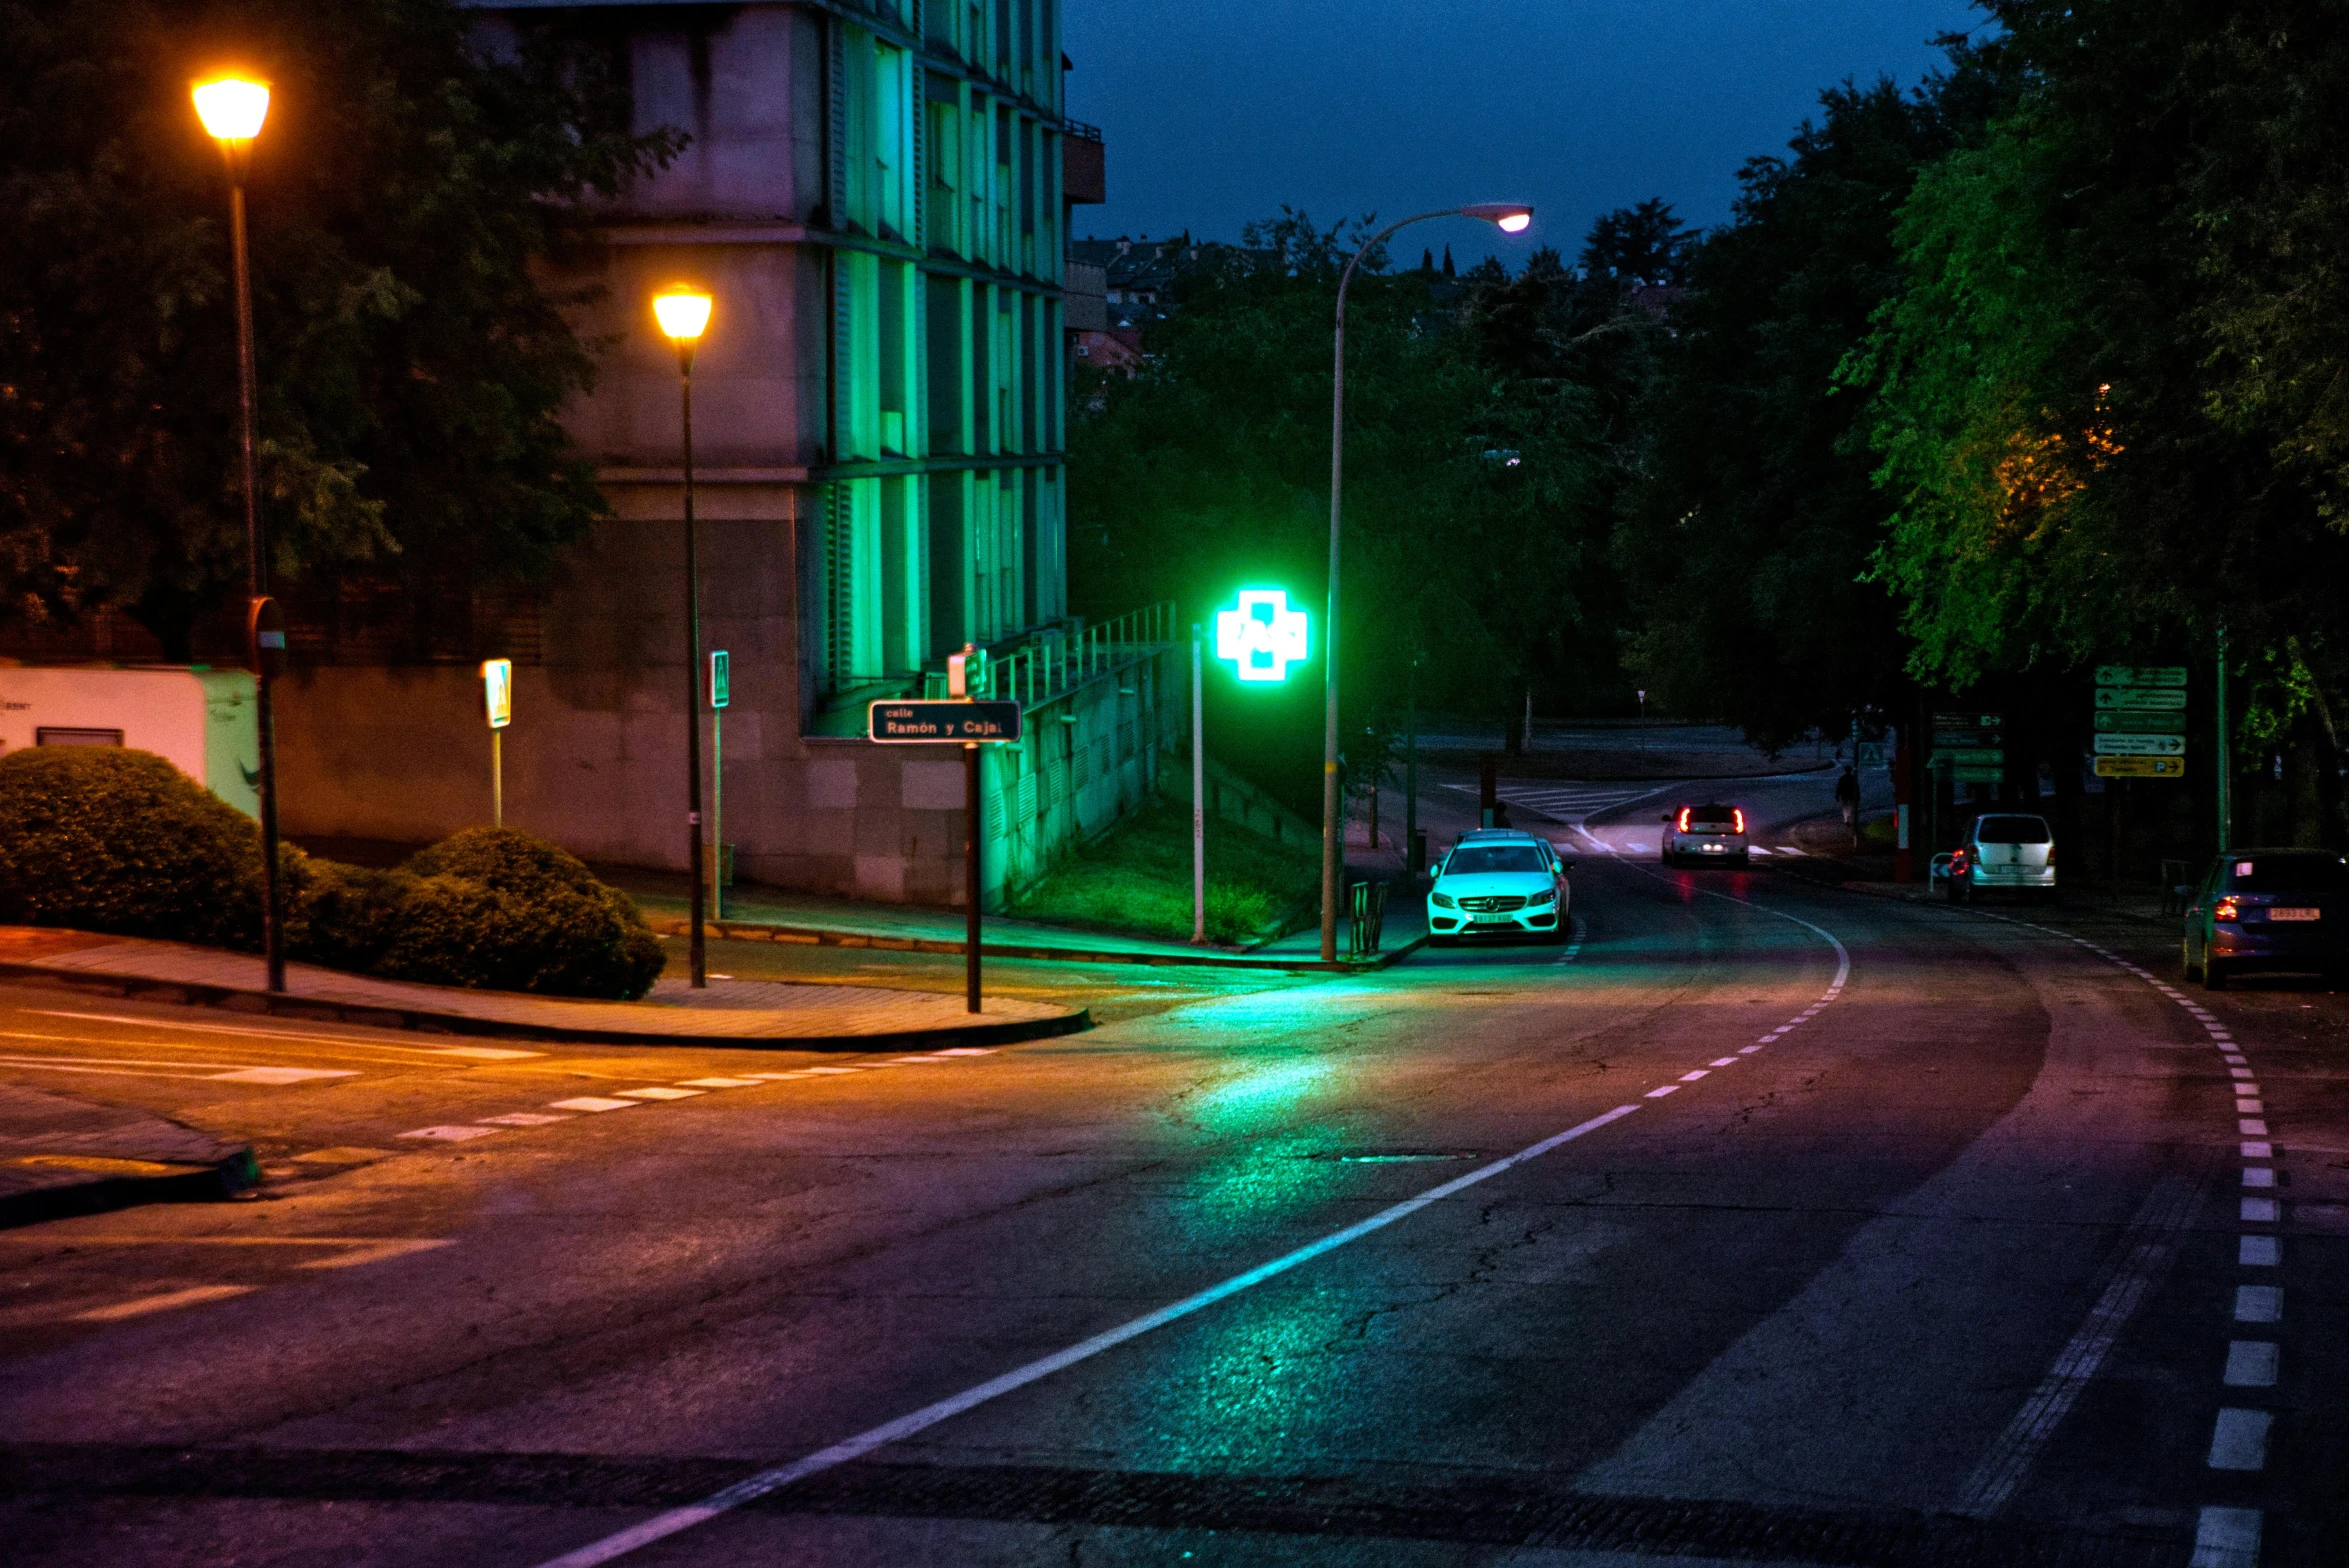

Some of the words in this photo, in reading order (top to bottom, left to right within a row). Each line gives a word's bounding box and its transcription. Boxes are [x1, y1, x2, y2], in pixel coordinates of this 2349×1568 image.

[886, 708, 914, 718] calle
[887, 721, 938, 734] Ramón
[945, 723, 955, 736] y
